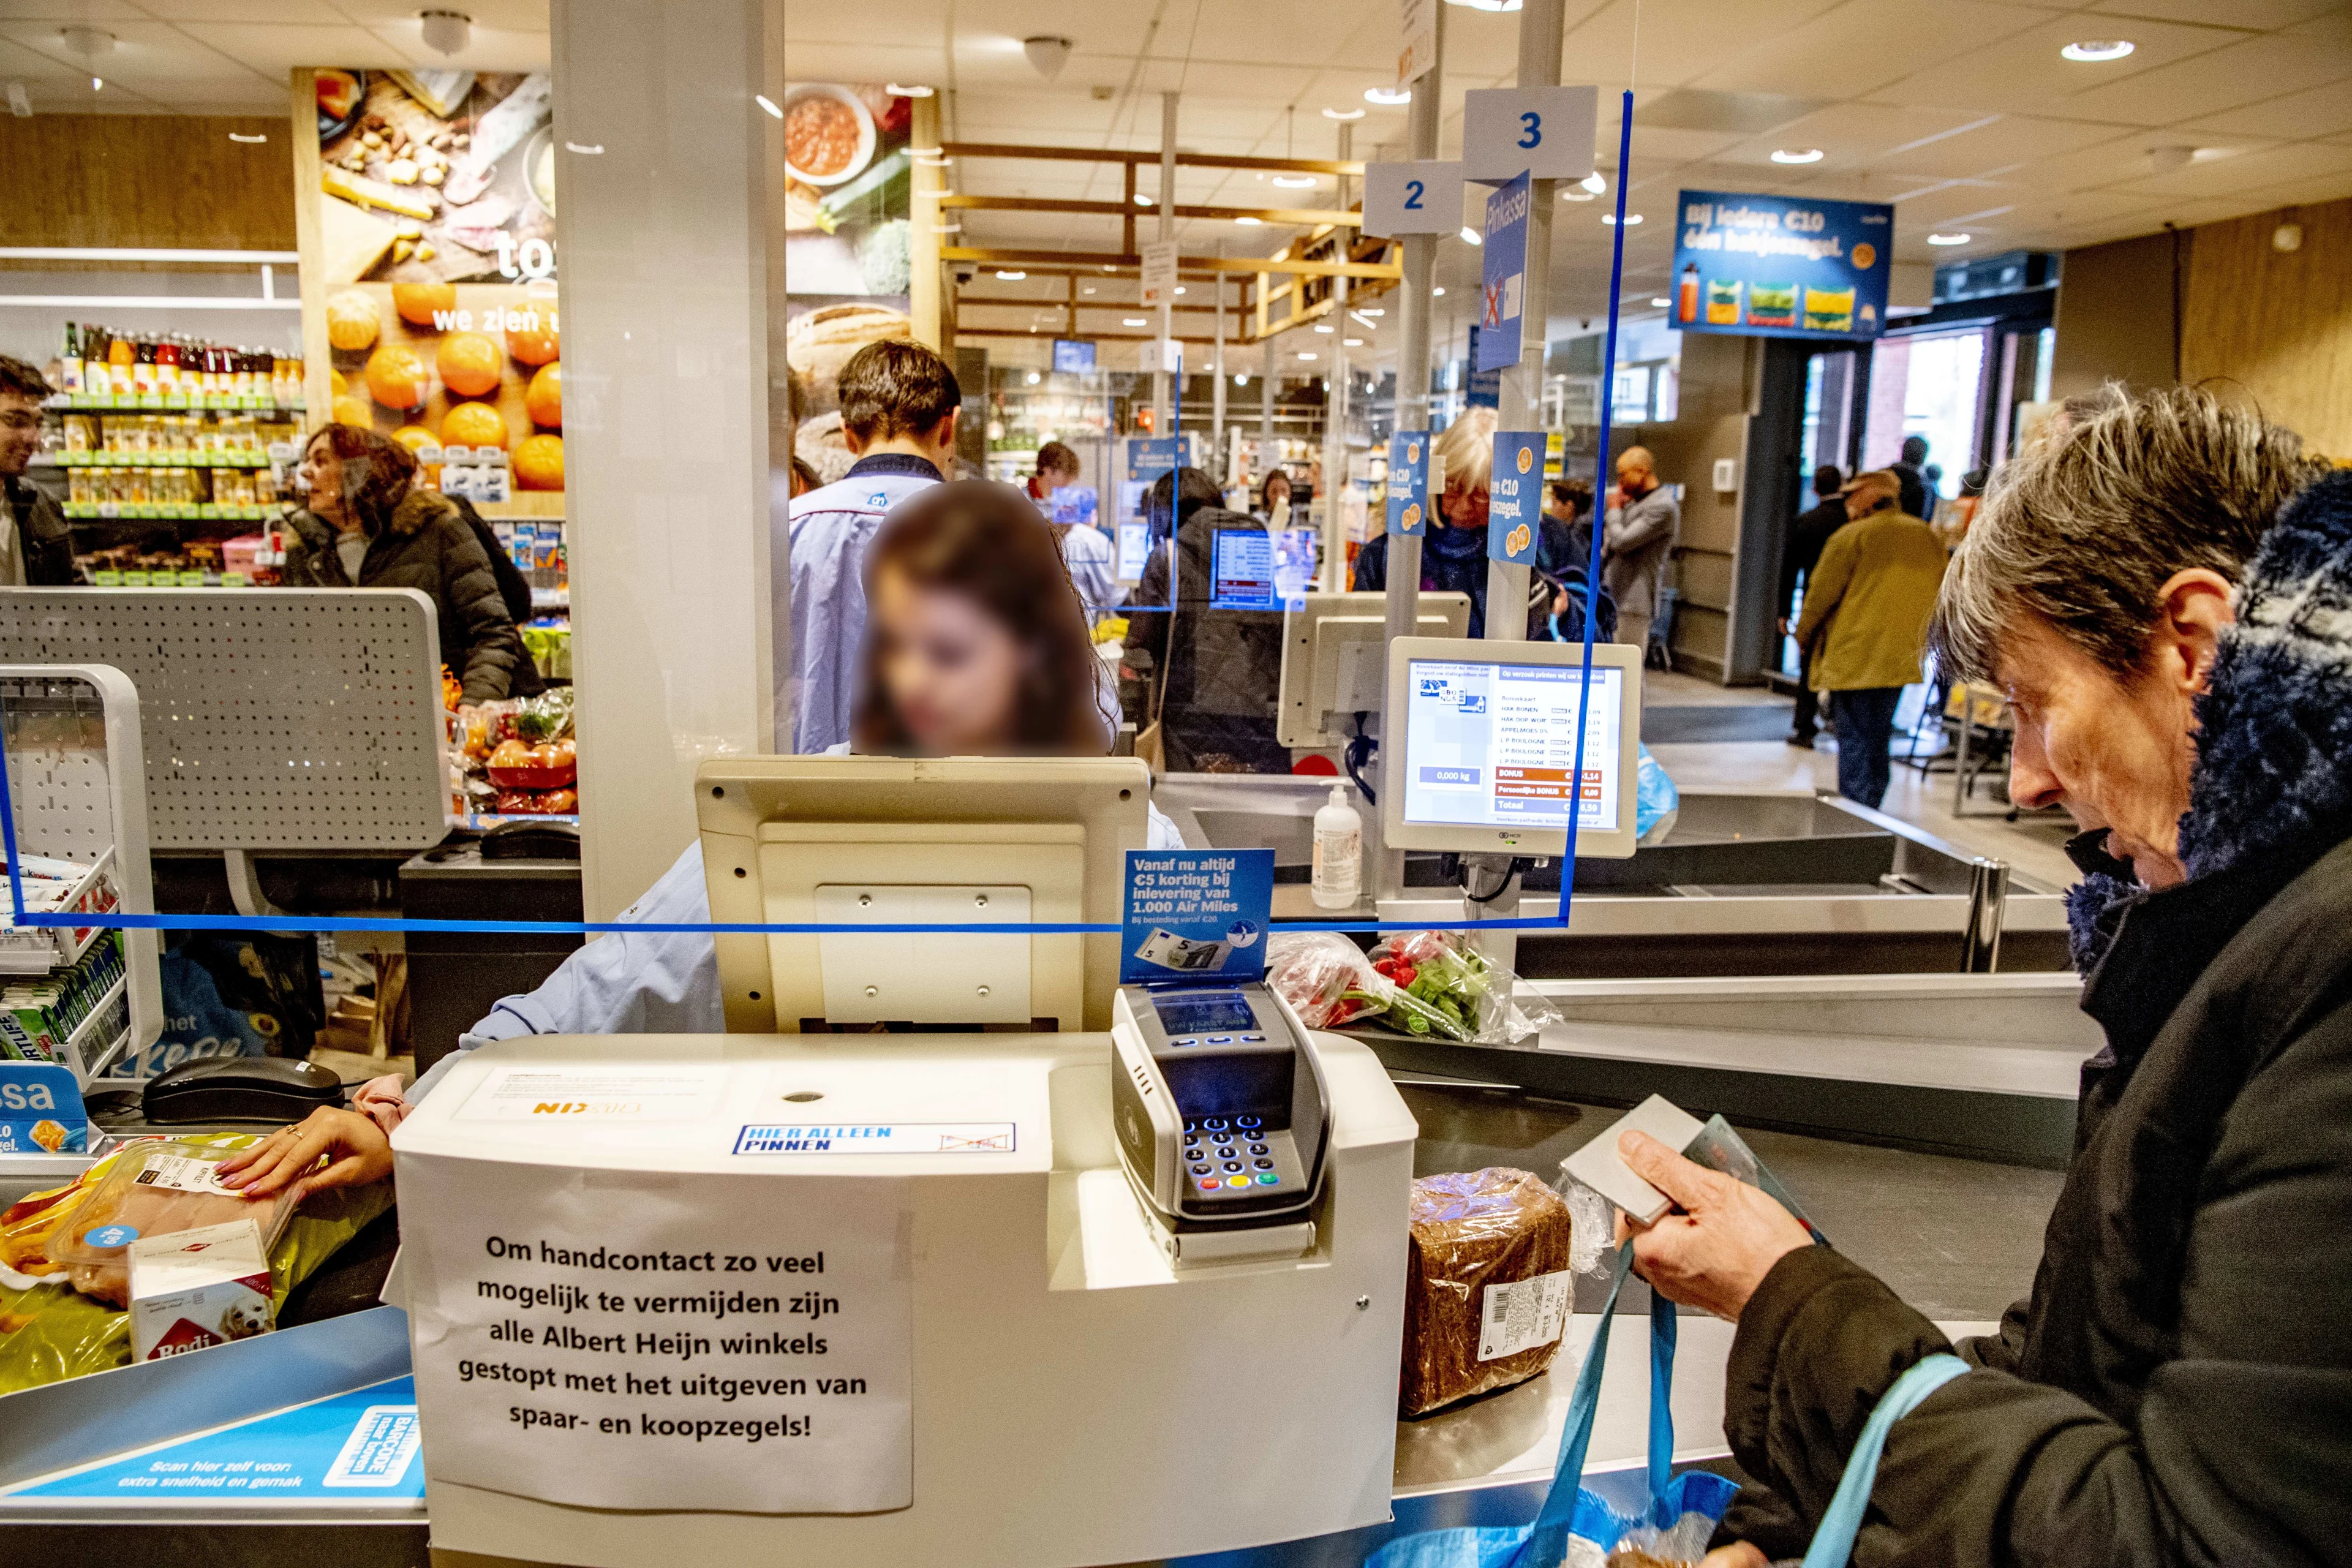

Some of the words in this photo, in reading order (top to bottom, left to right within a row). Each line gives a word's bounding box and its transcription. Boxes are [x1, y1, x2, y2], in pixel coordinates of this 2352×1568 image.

[1517, 111, 1542, 149] 3
[1404, 180, 1424, 209] 2
[1487, 189, 1526, 238] Pinkassa
[494, 230, 557, 279] to
[432, 309, 473, 331] we
[483, 305, 539, 333] zien
[1501, 479, 1518, 496] €10
[1536, 671, 1557, 679] printen
[1436, 771, 1459, 781] 0,000
[1460, 772, 1470, 782] kg
[1499, 769, 1523, 778] BONUS
[1498, 786, 1536, 796] Persoonlijke
[1536, 787, 1559, 796] BONUS
[1498, 800, 1523, 810] Totaal
[1134, 858, 1176, 871] Vanaf
[1178, 861, 1196, 871] nu
[1200, 858, 1235, 873] altijd
[28, 869, 54, 880] kinder
[1134, 873, 1155, 886] €5
[1159, 873, 1209, 888] korting
[1213, 872, 1230, 888] bij
[1133, 888, 1201, 901] inlevering
[1205, 889, 1230, 899] van
[1133, 902, 1172, 913] 1.000
[1176, 901, 1197, 913] Air
[1200, 901, 1238, 912] Miles
[1178, 940, 1191, 951] 5
[0, 1083, 56, 1110] sa
[0, 1125, 12, 1137] 0
[748, 1128, 802, 1139] HIER
[809, 1127, 892, 1139] ALLEEN
[744, 1140, 831, 1152] PINNEN
[192, 1167, 210, 1184] KIPFILET
[486, 1235, 532, 1261] Om
[540, 1240, 715, 1272] handcontact
[725, 1254, 757, 1272] zo
[767, 1252, 824, 1273] veel
[477, 1280, 589, 1314] mogelijk
[598, 1291, 625, 1312] te
[634, 1291, 780, 1319] vermijden
[789, 1291, 840, 1319] zijn
[490, 1320, 535, 1344] alle
[543, 1326, 626, 1353] Albert
[636, 1332, 710, 1360] Heijn
[721, 1332, 828, 1355] winkels
[459, 1359, 557, 1390] gestopt
[565, 1373, 617, 1393] met
[626, 1372, 672, 1395] het
[680, 1374, 807, 1401] uitgeven
[816, 1376, 867, 1395] van
[372, 1417, 394, 1440] naar
[510, 1407, 590, 1430] spaar-
[599, 1414, 631, 1434] en
[642, 1414, 812, 1442] koopzegels!
[368, 1417, 413, 1473] BARCODE
[352, 1441, 383, 1472] boven
[149, 1461, 188, 1472] Scan
[190, 1461, 224, 1472] hier
[223, 1460, 255, 1472] zelf
[118, 1476, 158, 1487] extra
[159, 1476, 227, 1488] snelheid
[227, 1477, 248, 1488] en
[247, 1476, 304, 1490] gemak
